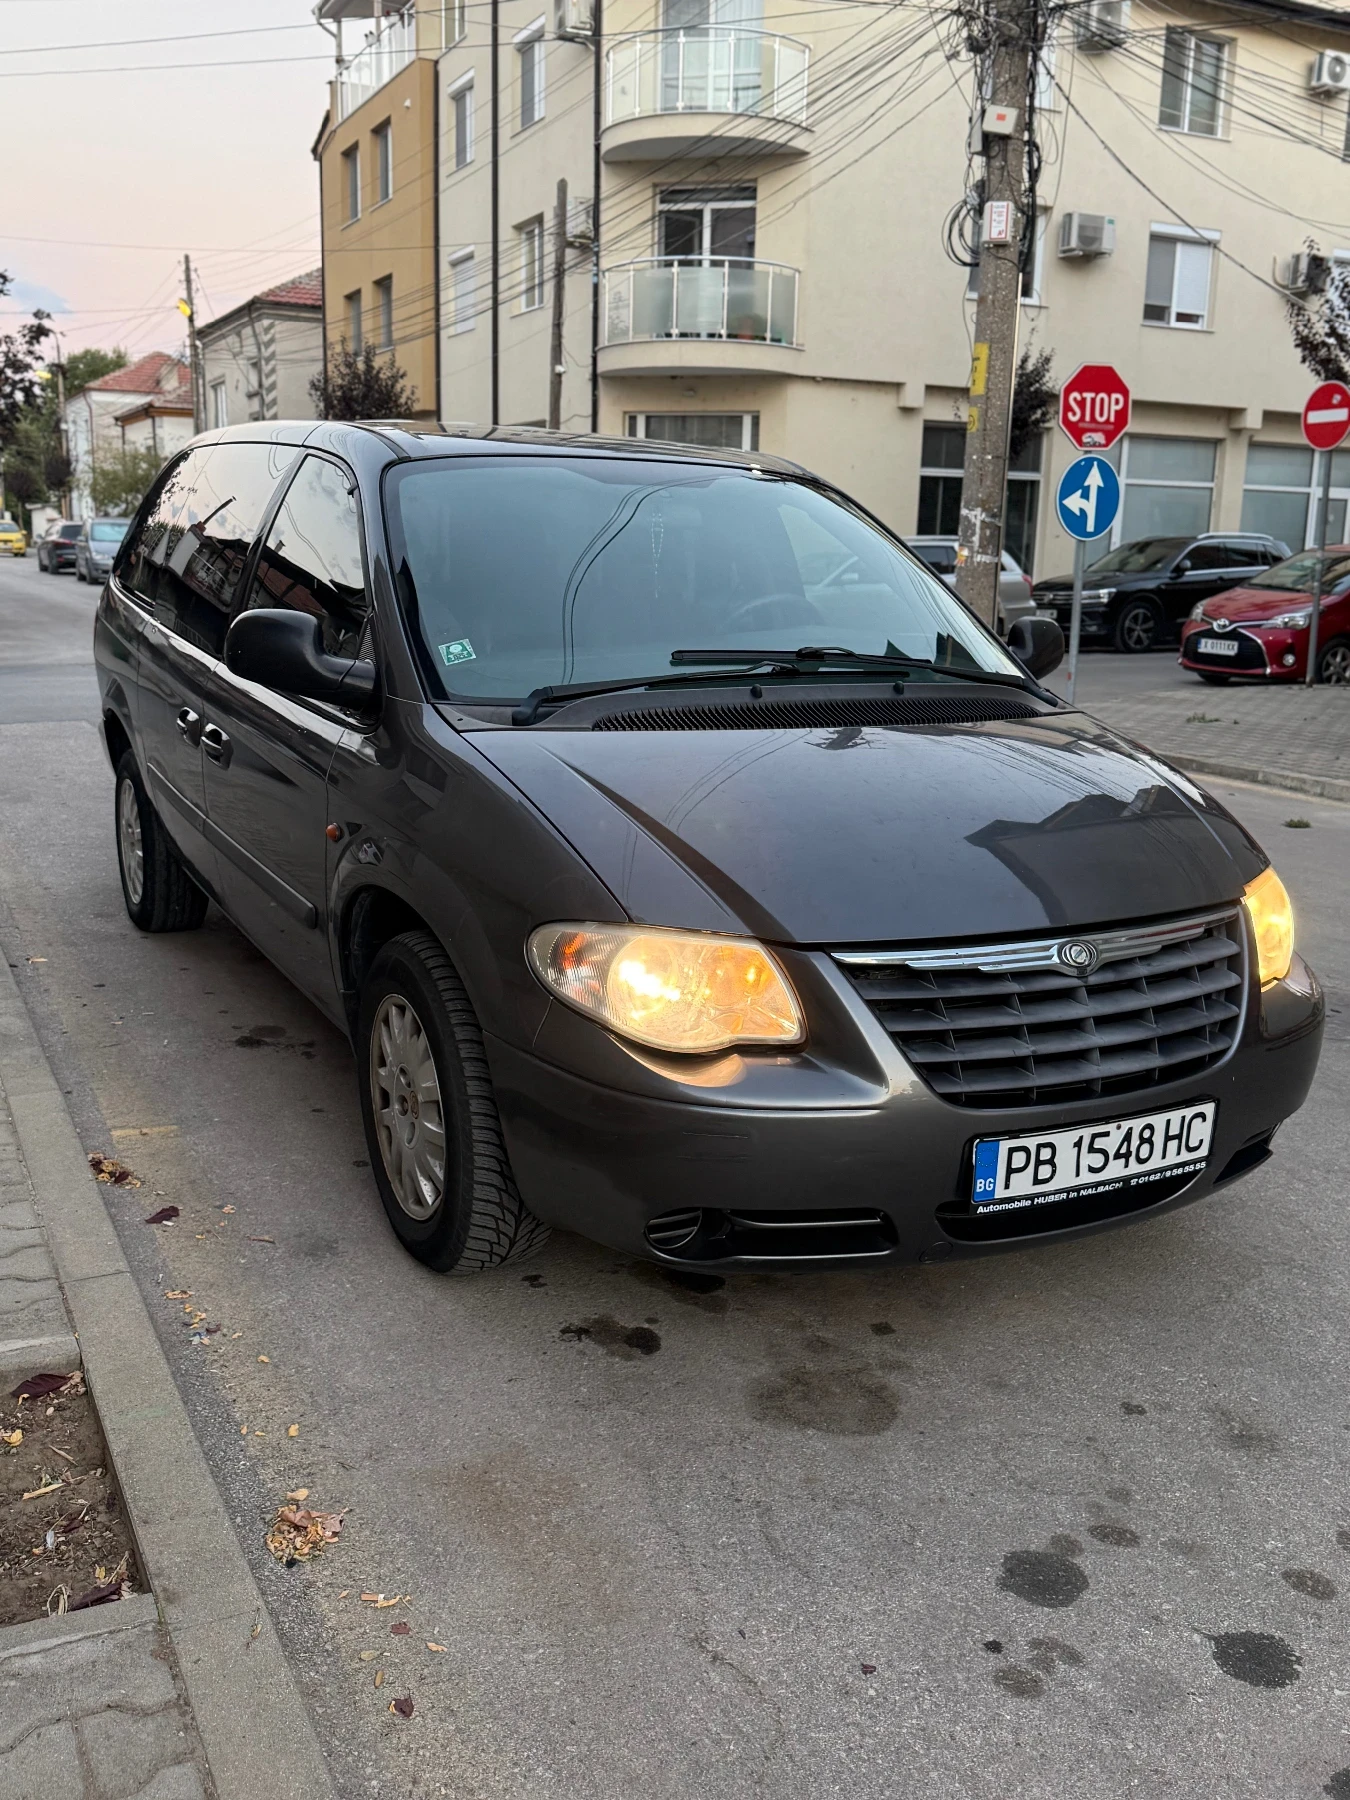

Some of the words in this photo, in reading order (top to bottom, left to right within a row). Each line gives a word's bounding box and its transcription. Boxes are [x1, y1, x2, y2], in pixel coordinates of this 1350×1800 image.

[1067, 391, 1124, 423] STOP
[1003, 1142, 1057, 1190] PB
[1072, 1123, 1155, 1178] 1548
[1160, 1111, 1207, 1160] HC
[976, 1178, 994, 1193] BG
[976, 1199, 1032, 1214] Automobile
[1033, 1191, 1067, 1205] HUBER
[1068, 1190, 1078, 1198] in
[1079, 1181, 1123, 1197] NALBACH
